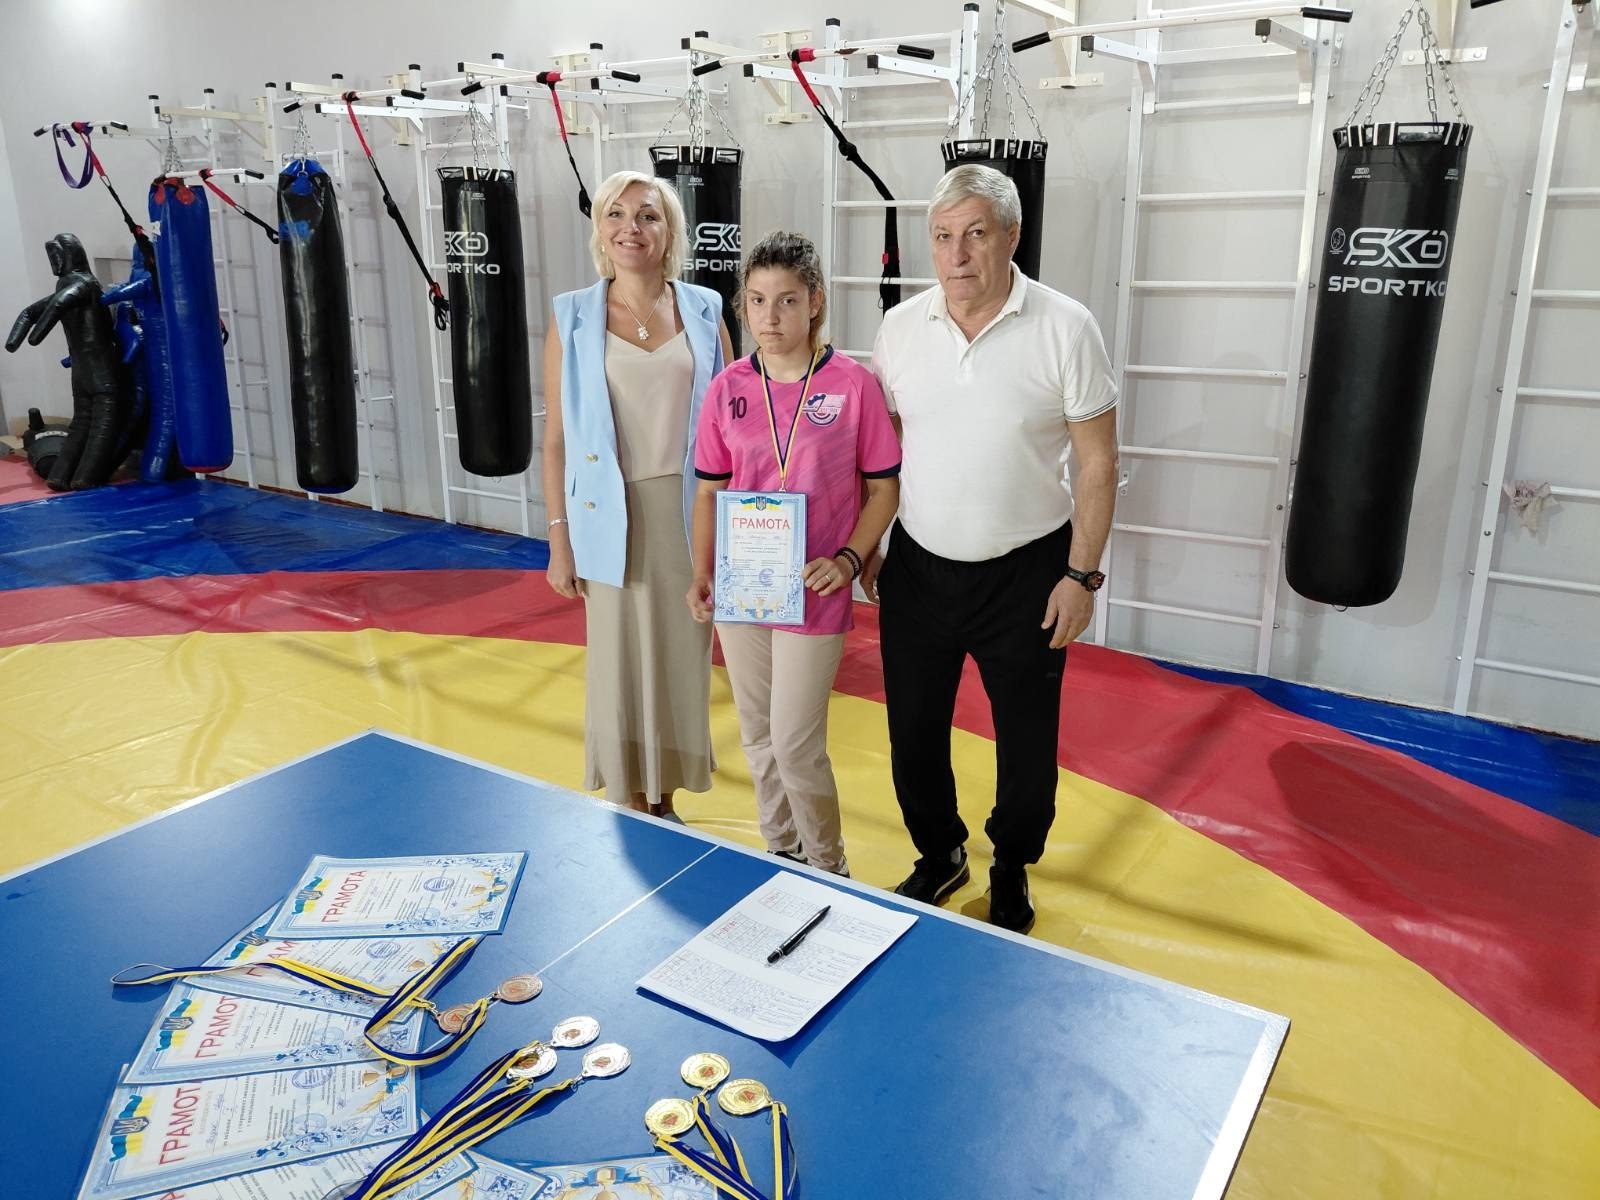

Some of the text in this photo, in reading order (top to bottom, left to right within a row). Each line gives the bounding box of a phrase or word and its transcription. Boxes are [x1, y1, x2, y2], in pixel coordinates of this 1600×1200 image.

[728, 396, 747, 420] 10
[732, 517, 791, 530] ГРАМОТА
[321, 870, 368, 922] ГРАМОТА
